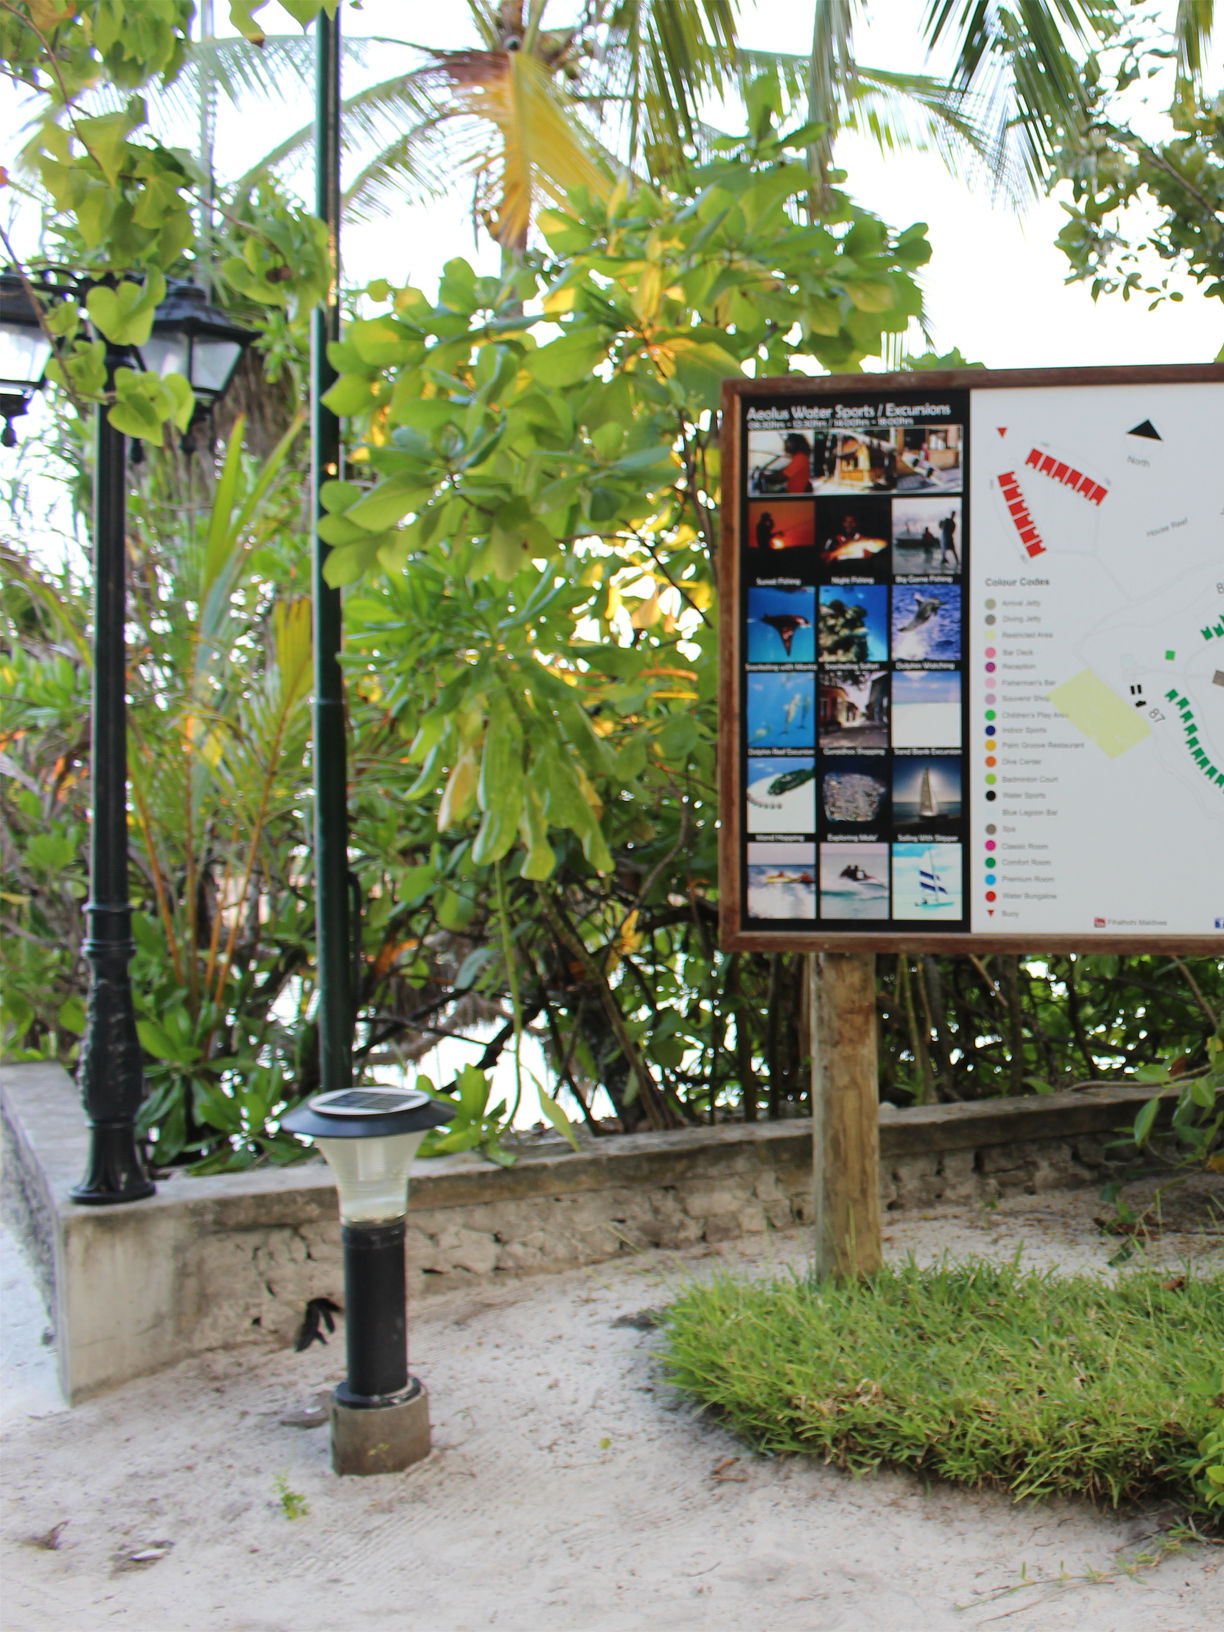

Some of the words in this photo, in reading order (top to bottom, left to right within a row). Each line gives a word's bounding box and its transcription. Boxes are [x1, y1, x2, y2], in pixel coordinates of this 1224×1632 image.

[746, 406, 790, 421] Aeolus
[791, 405, 832, 420] Water
[834, 403, 875, 421] Sports
[885, 402, 952, 417] Excursions
[1126, 455, 1151, 467] North
[1146, 525, 1170, 538] House
[1170, 516, 1189, 529] Reef
[985, 577, 1018, 587] Colour
[1019, 577, 1051, 586] Codes
[1148, 707, 1166, 724] 87
